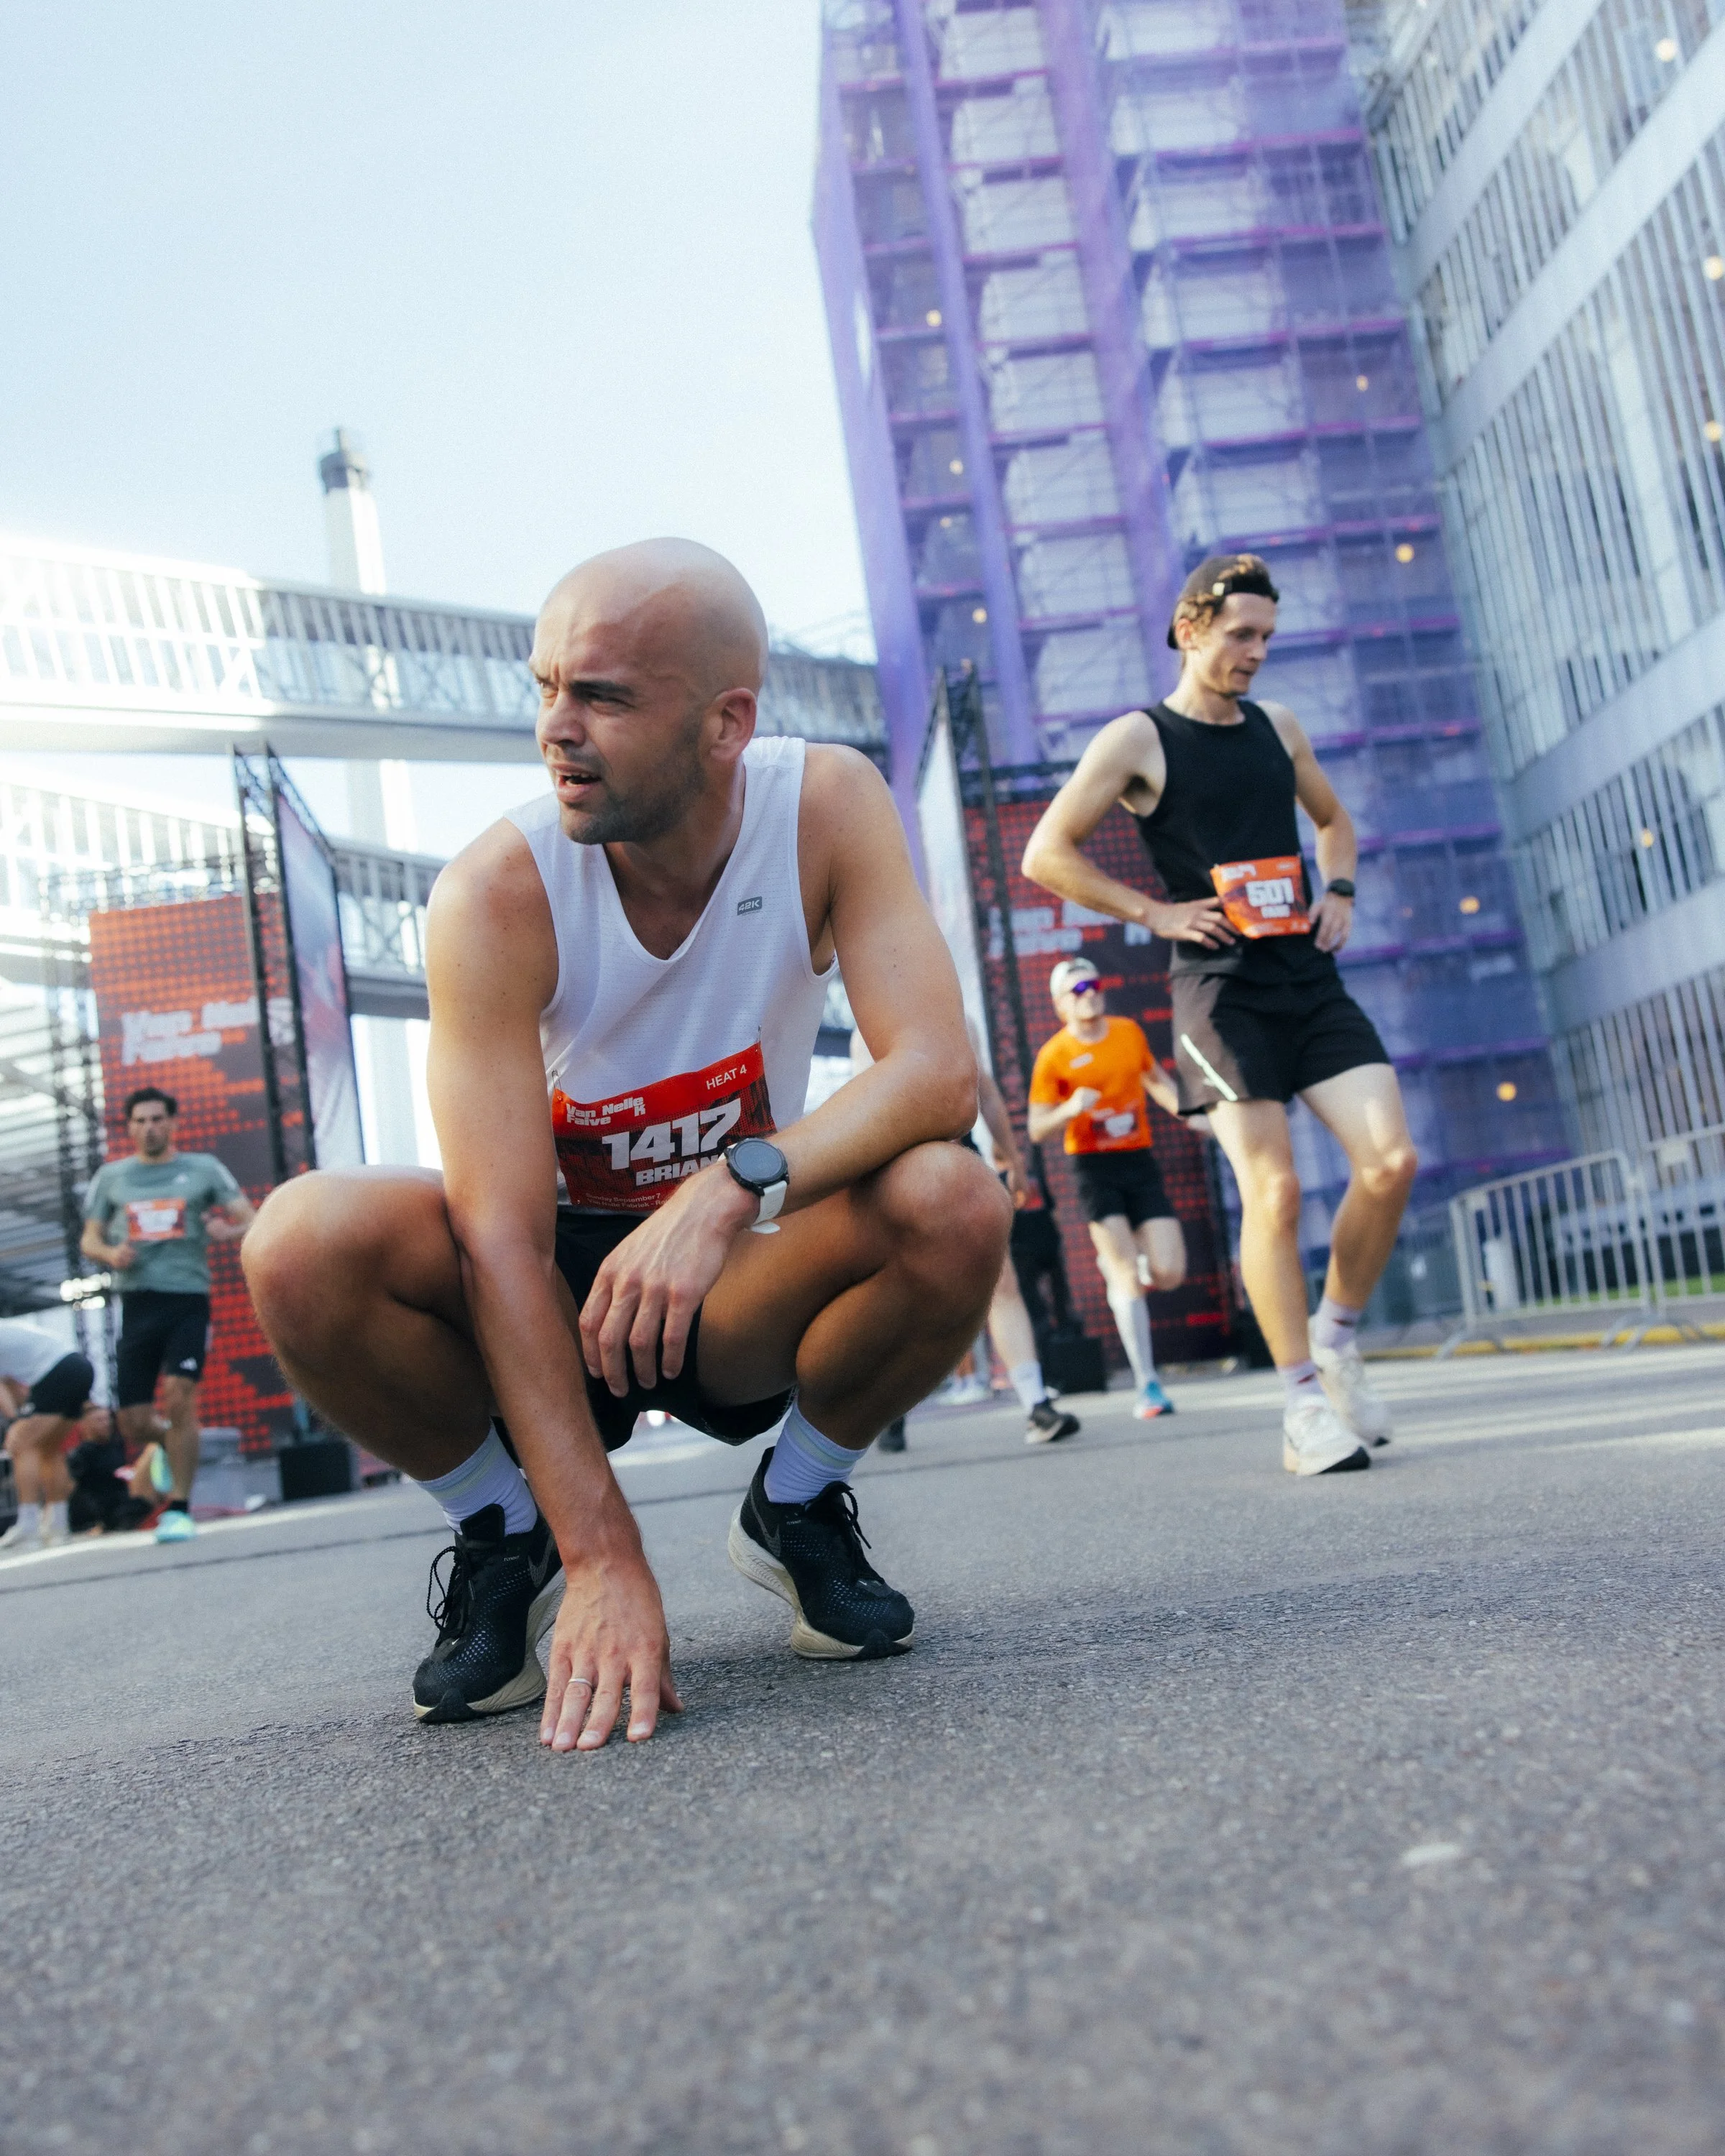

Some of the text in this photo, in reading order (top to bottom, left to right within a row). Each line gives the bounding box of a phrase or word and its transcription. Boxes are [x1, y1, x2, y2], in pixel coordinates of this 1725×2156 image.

[706, 1064, 748, 1090] HEAT 4
[566, 1097, 644, 1118] Van Nelle
[634, 1103, 646, 1117] K
[602, 1098, 742, 1170] 1417
[586, 1193, 612, 1202] Sunday
[613, 1194, 656, 1203] September
